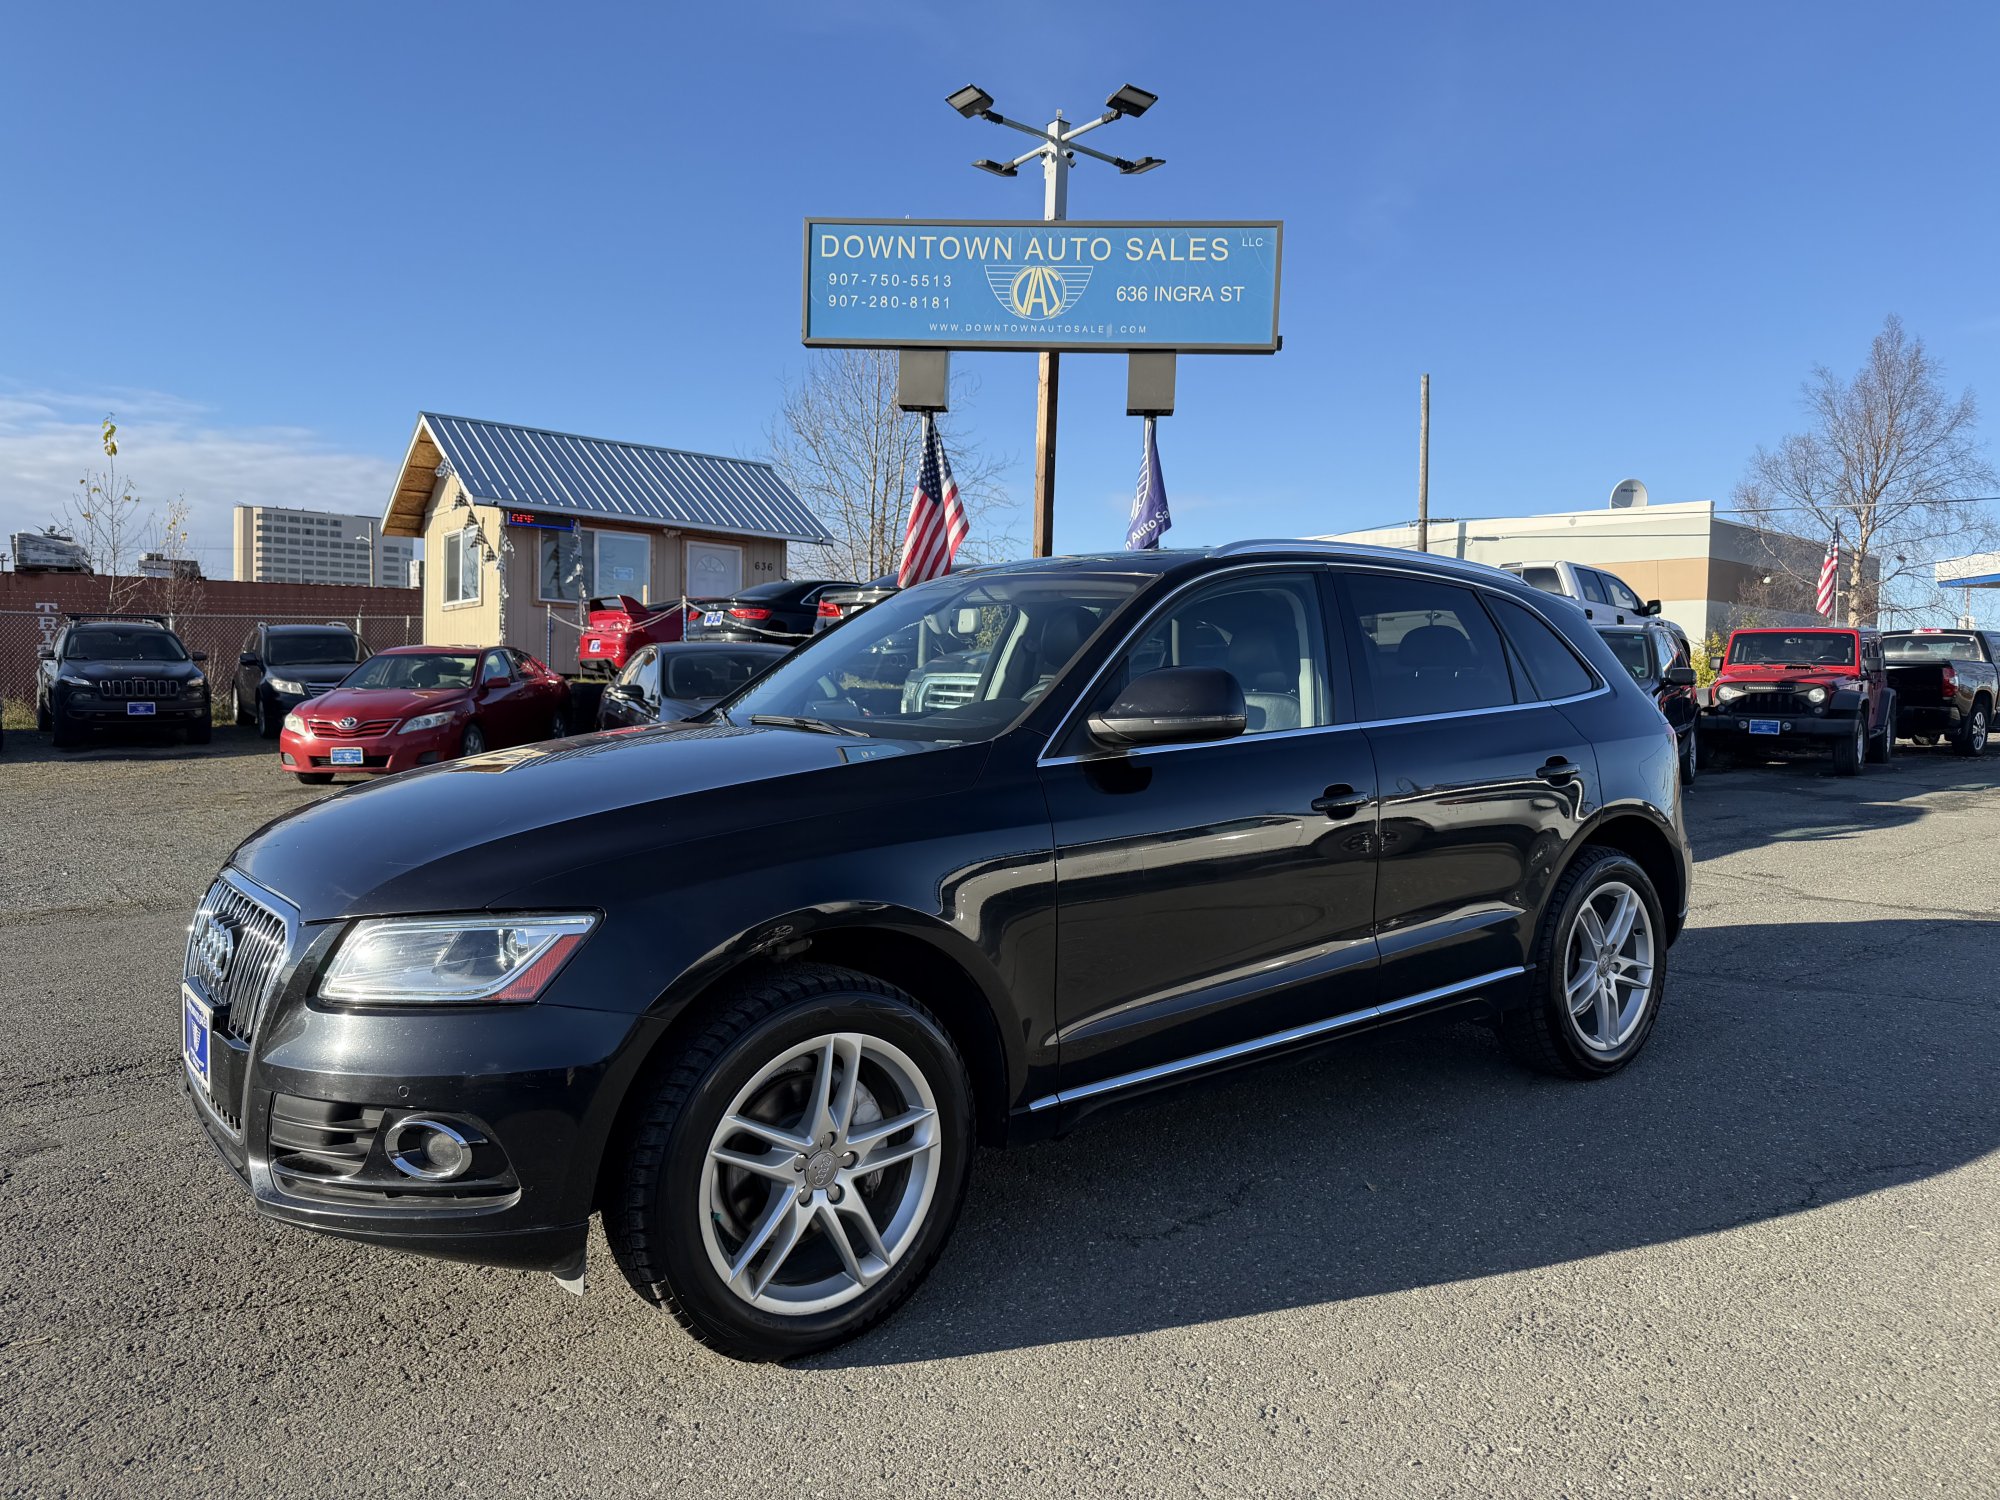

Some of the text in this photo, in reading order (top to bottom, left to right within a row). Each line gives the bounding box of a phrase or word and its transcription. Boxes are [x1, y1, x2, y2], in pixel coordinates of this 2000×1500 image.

[821, 235, 1264, 262] DOWNTOWN AUTO SALES LLC
[828, 272, 952, 288] 907-750-5513
[828, 294, 950, 309] 907-280-8181
[1116, 286, 1245, 303] 636 INGRA ST
[929, 322, 1147, 335] WWW.DOWNTOWNAUTOSALE.COM
[1131, 519, 1157, 544] Auto
[754, 561, 773, 571] 636
